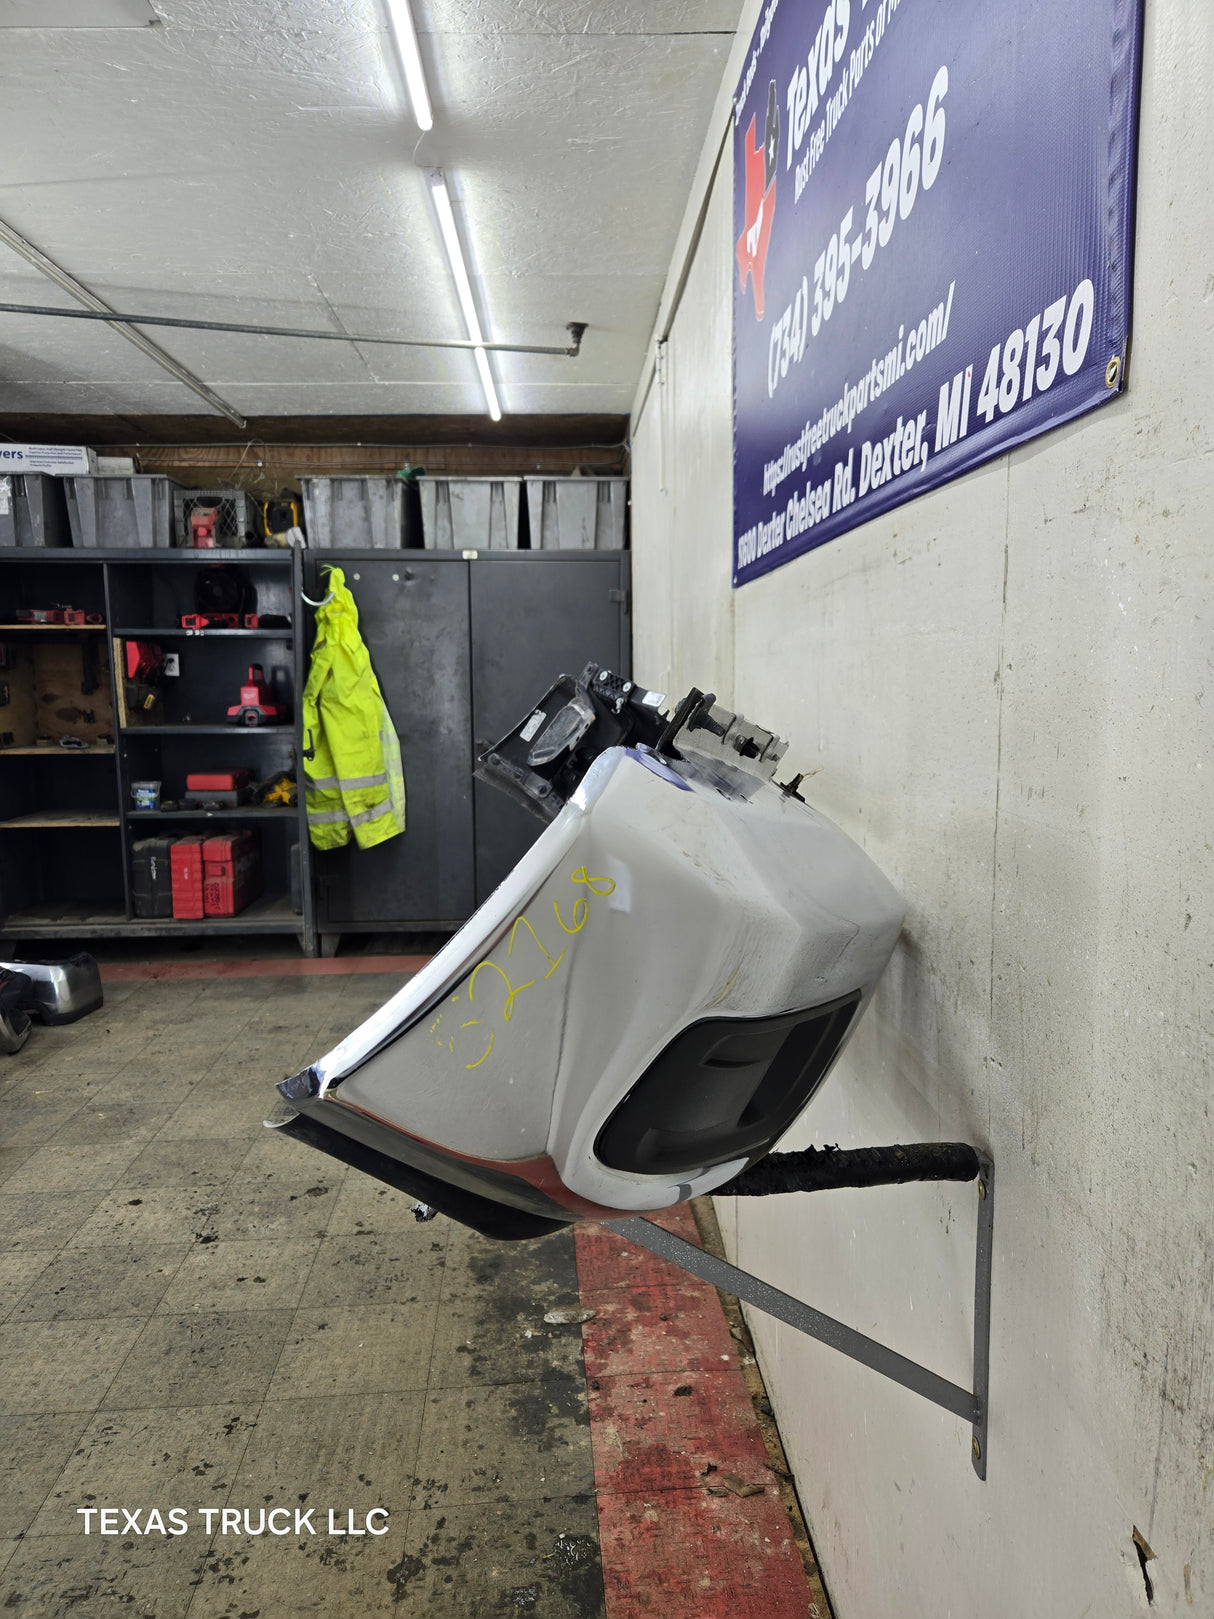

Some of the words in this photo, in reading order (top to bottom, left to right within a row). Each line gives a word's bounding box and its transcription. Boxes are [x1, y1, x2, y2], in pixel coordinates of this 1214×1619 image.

[786, 0, 850, 171] Texas
[809, 119, 826, 176] Free
[825, 66, 849, 144] Truck
[848, 19, 875, 100] Parts
[767, 275, 808, 399] (734)
[811, 64, 949, 337] 395-3966
[756, 511, 786, 559] Dexter
[785, 478, 832, 541] Chelsea
[831, 447, 856, 514] Rd.
[858, 409, 929, 498] Dexter,
[934, 364, 973, 453] MI
[976, 278, 1095, 423] 48130
